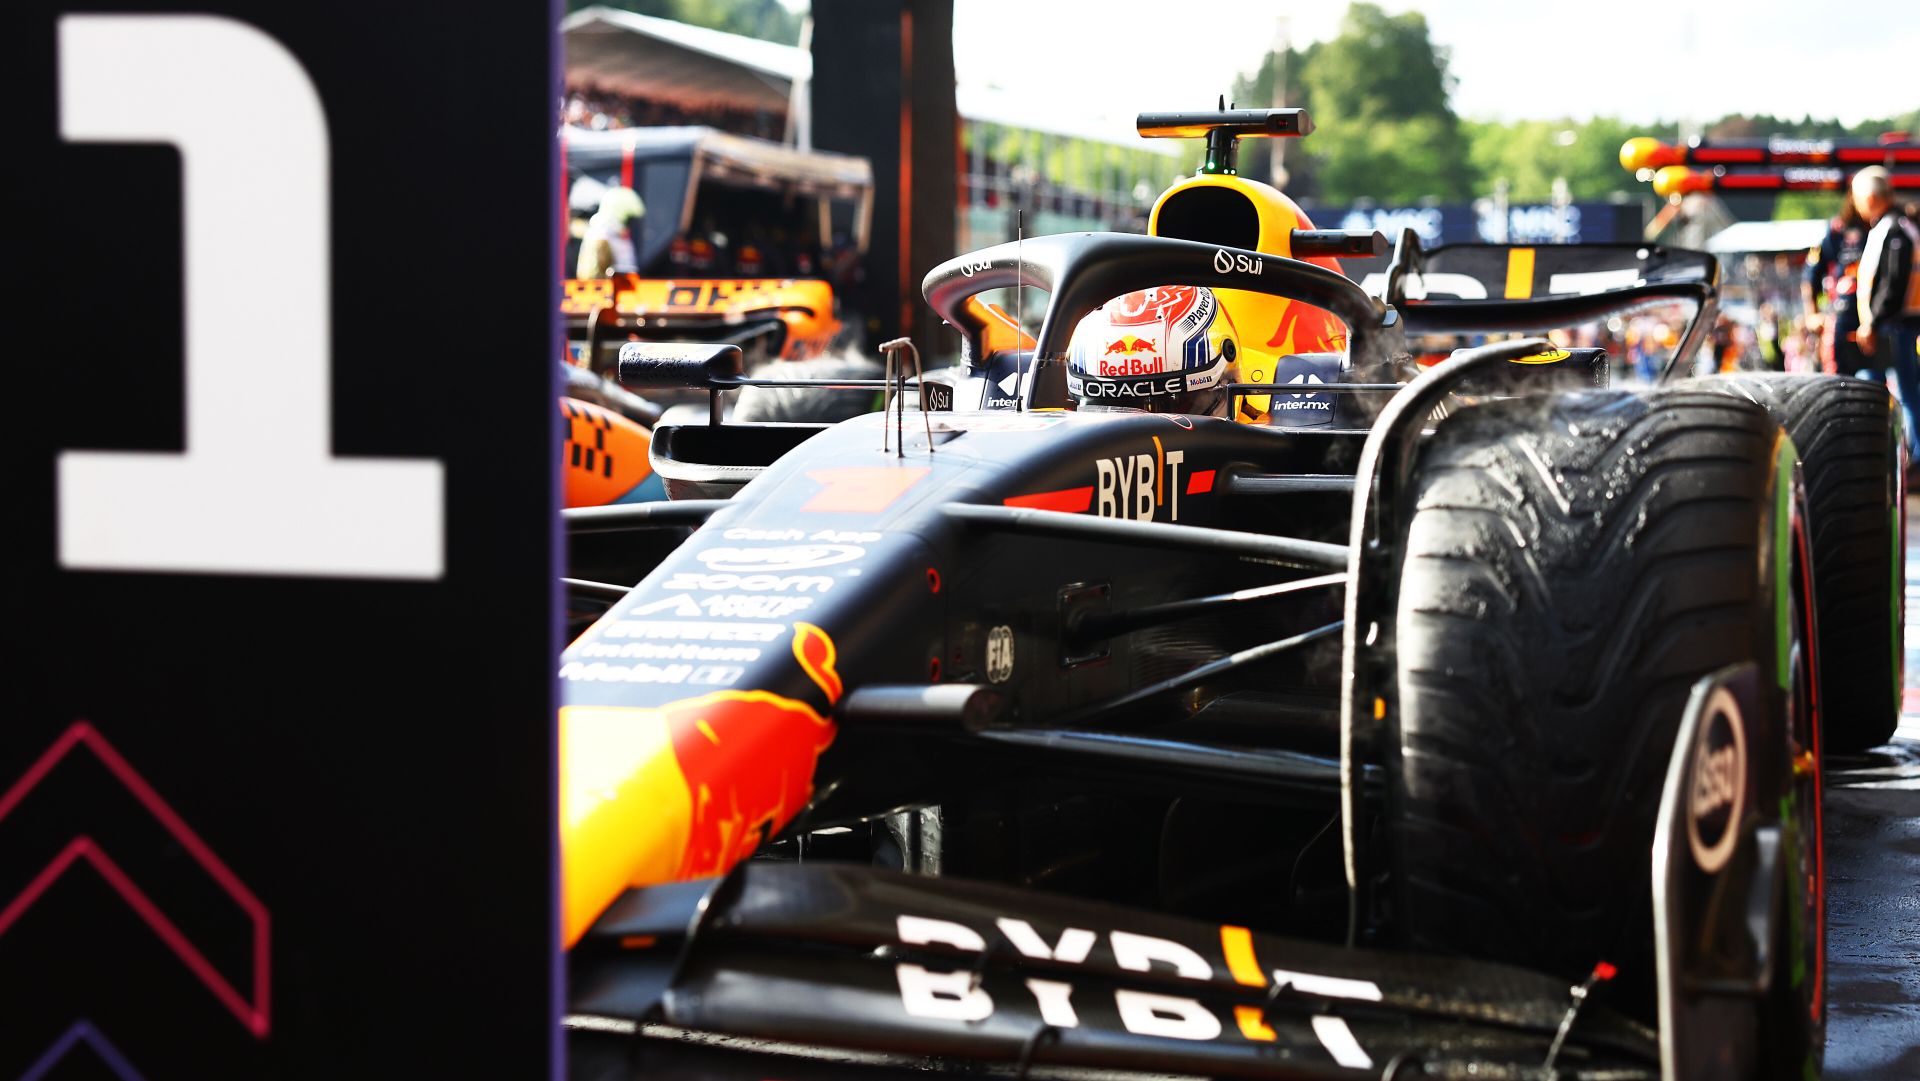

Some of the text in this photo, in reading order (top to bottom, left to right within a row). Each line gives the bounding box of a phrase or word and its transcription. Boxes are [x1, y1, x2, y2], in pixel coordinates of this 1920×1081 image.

[1236, 254, 1262, 275] Sui
[58, 15, 445, 580] 1
[1187, 296, 1210, 326] Player
[1100, 356, 1163, 376] Red Bull
[1085, 378, 1182, 398] ORACLE
[1190, 378, 1207, 386] Mobil
[937, 391, 949, 409] Sui
[1273, 400, 1330, 411] inter.mx
[1096, 435, 1184, 522] BYBIT
[808, 528, 882, 542] App
[662, 573, 834, 593] zoom
[896, 915, 1383, 1070] BYBIT
